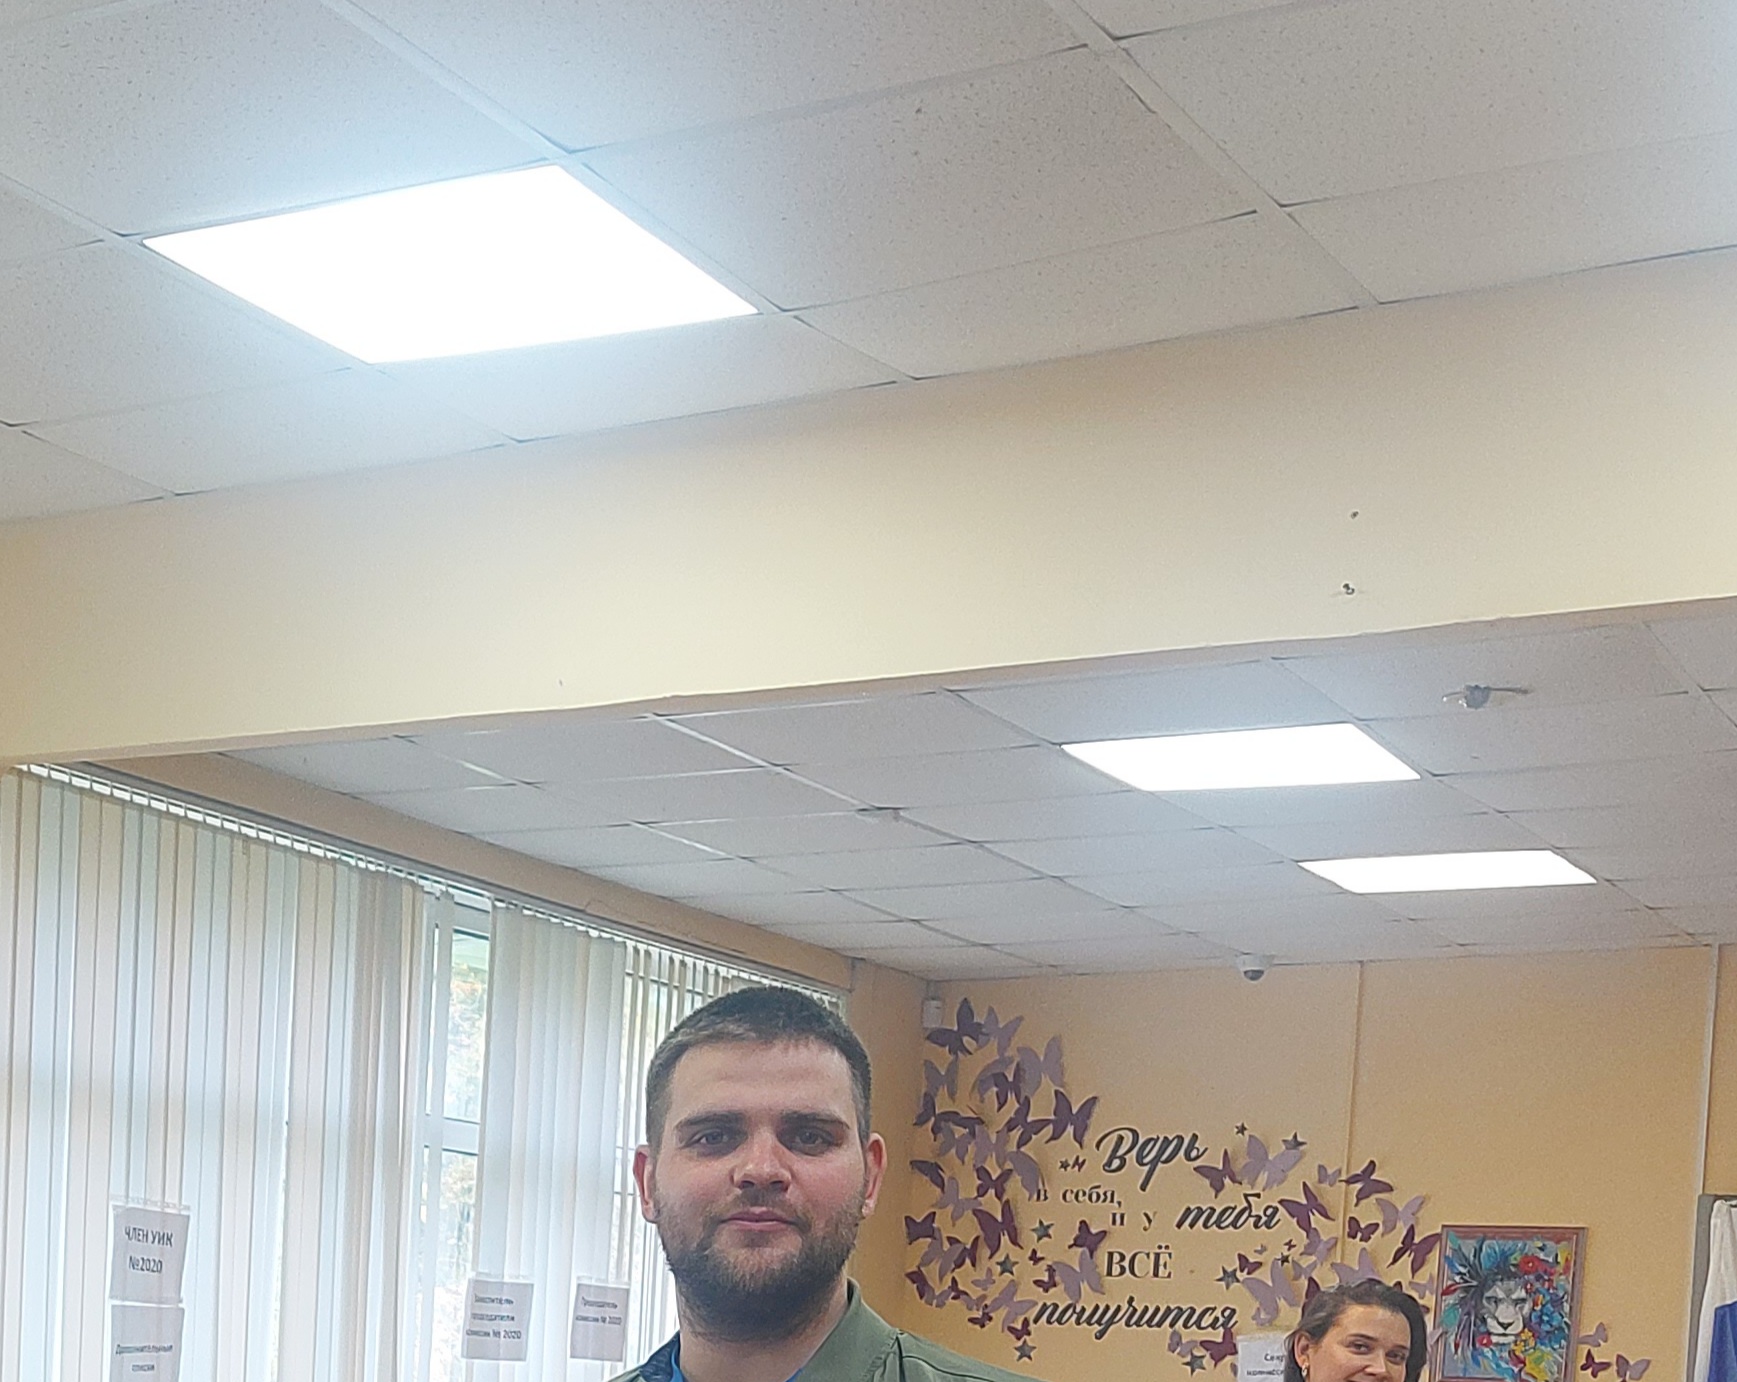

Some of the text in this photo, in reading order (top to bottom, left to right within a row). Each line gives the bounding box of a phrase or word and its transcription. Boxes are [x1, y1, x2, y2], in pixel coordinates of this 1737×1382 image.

[1095, 1127, 1208, 1192] Верь
[1062, 1185, 1122, 1208] себя,
[1111, 1212, 1125, 1226] и
[1175, 1192, 1282, 1230] тебя
[124, 1226, 173, 1247] ЧЛЕН УИК
[129, 1255, 163, 1273] №2020
[1105, 1244, 1172, 1279] ВСЁ
